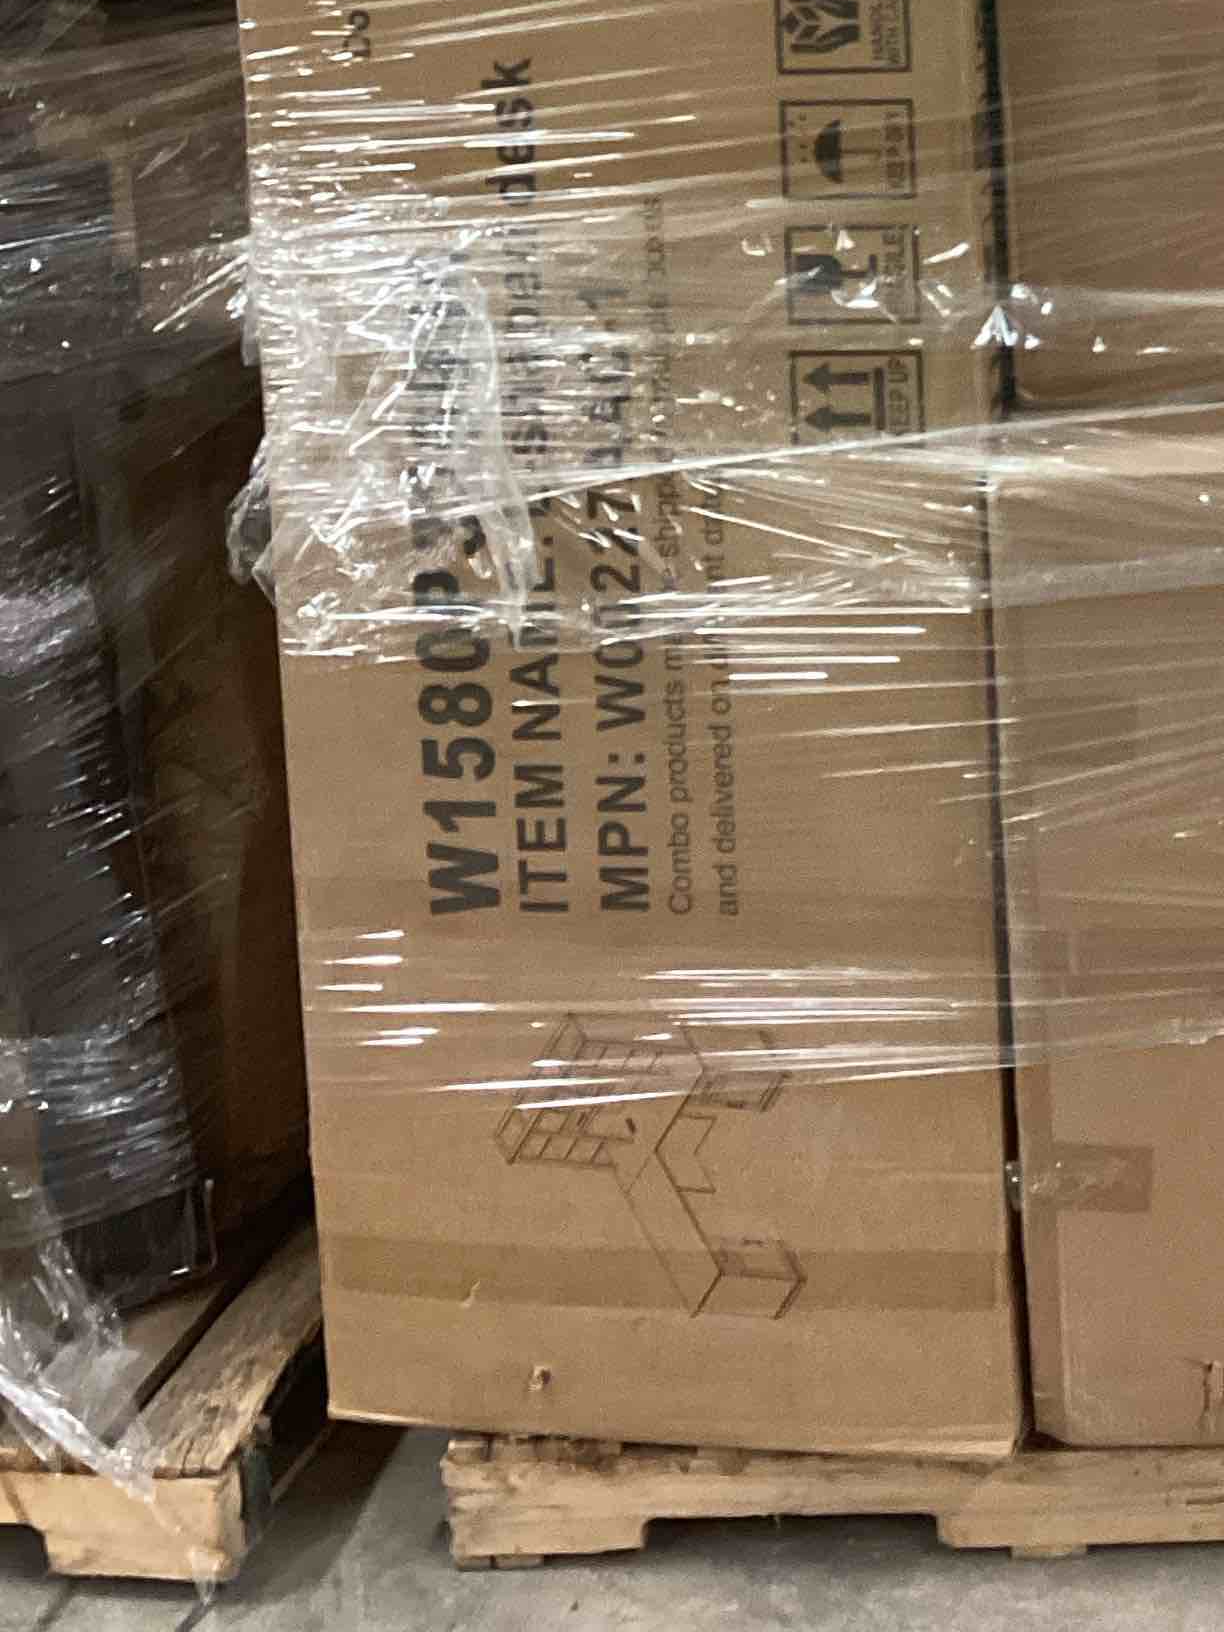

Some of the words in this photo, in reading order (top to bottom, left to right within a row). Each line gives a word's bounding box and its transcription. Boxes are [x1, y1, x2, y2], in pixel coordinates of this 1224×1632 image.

[664, 679, 693, 804] products
[708, 725, 738, 855] delivered
[515, 759, 569, 914] ITEM
[597, 752, 650, 913] MPN:
[668, 812, 692, 916] Combo
[712, 863, 739, 917] and
